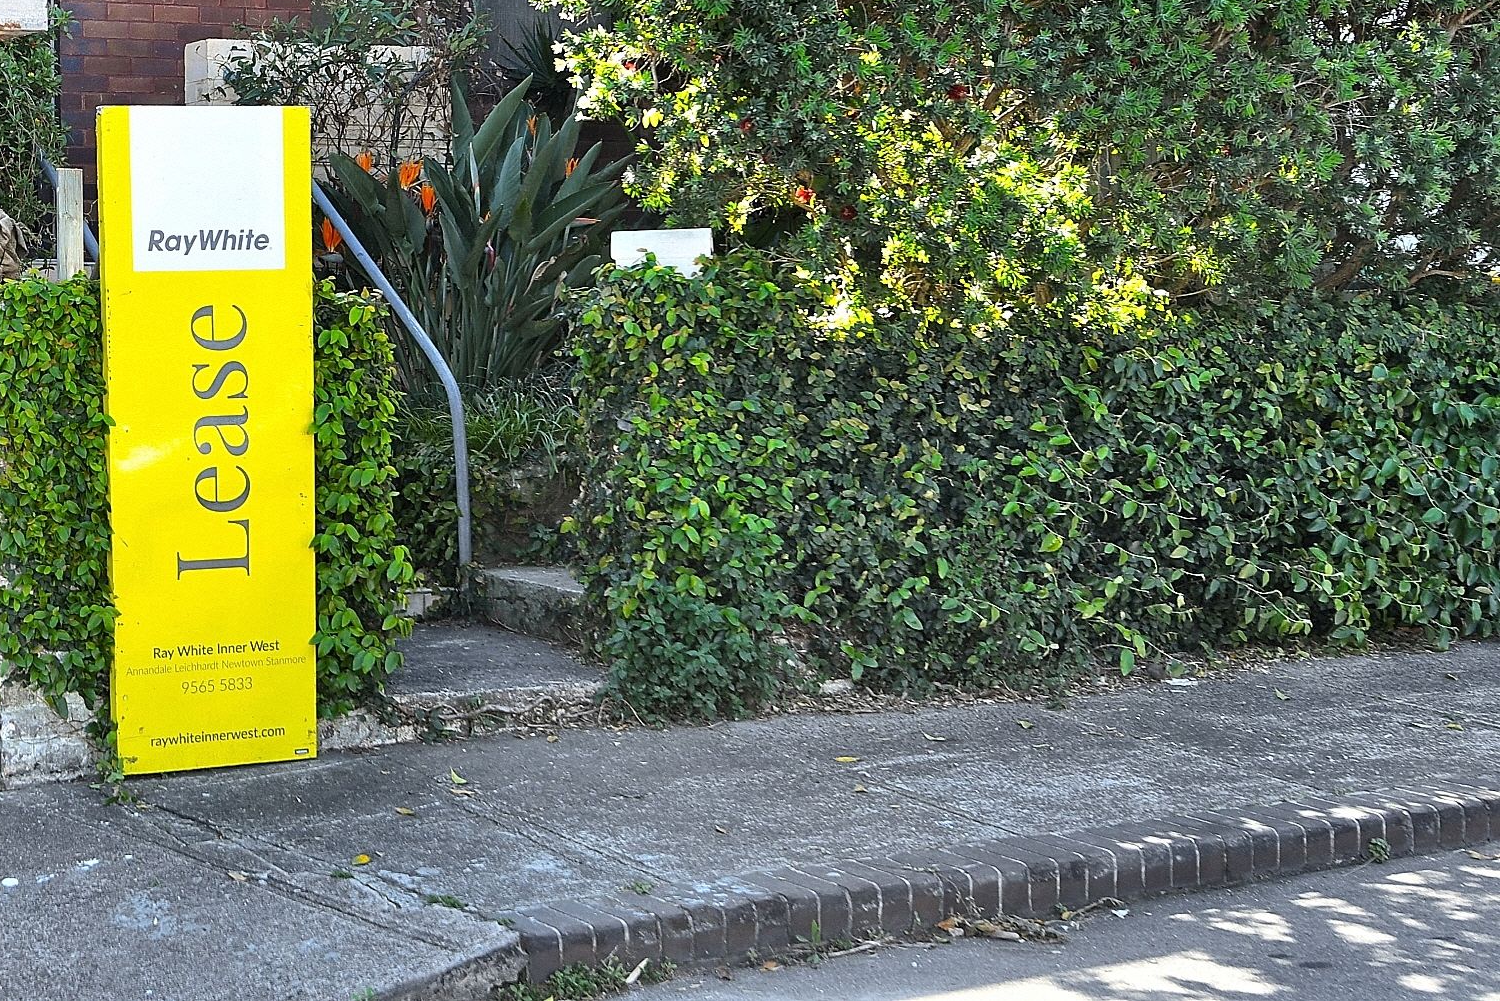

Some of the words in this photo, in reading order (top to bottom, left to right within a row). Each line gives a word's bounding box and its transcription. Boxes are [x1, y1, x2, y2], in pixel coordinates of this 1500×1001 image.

[176, 303, 251, 581] Lease
[153, 647, 175, 661] Ray
[177, 643, 214, 658] White
[217, 641, 248, 655] Inner
[250, 639, 280, 652] West
[126, 663, 172, 677] Annandale
[174, 659, 219, 673] Leichhardt
[221, 656, 264, 670] Newtown
[265, 654, 307, 666] Stanmore
[181, 679, 215, 694] 9565
[220, 676, 253, 692] 5833
[151, 726, 285, 748] raywhiteinnerwest.com
